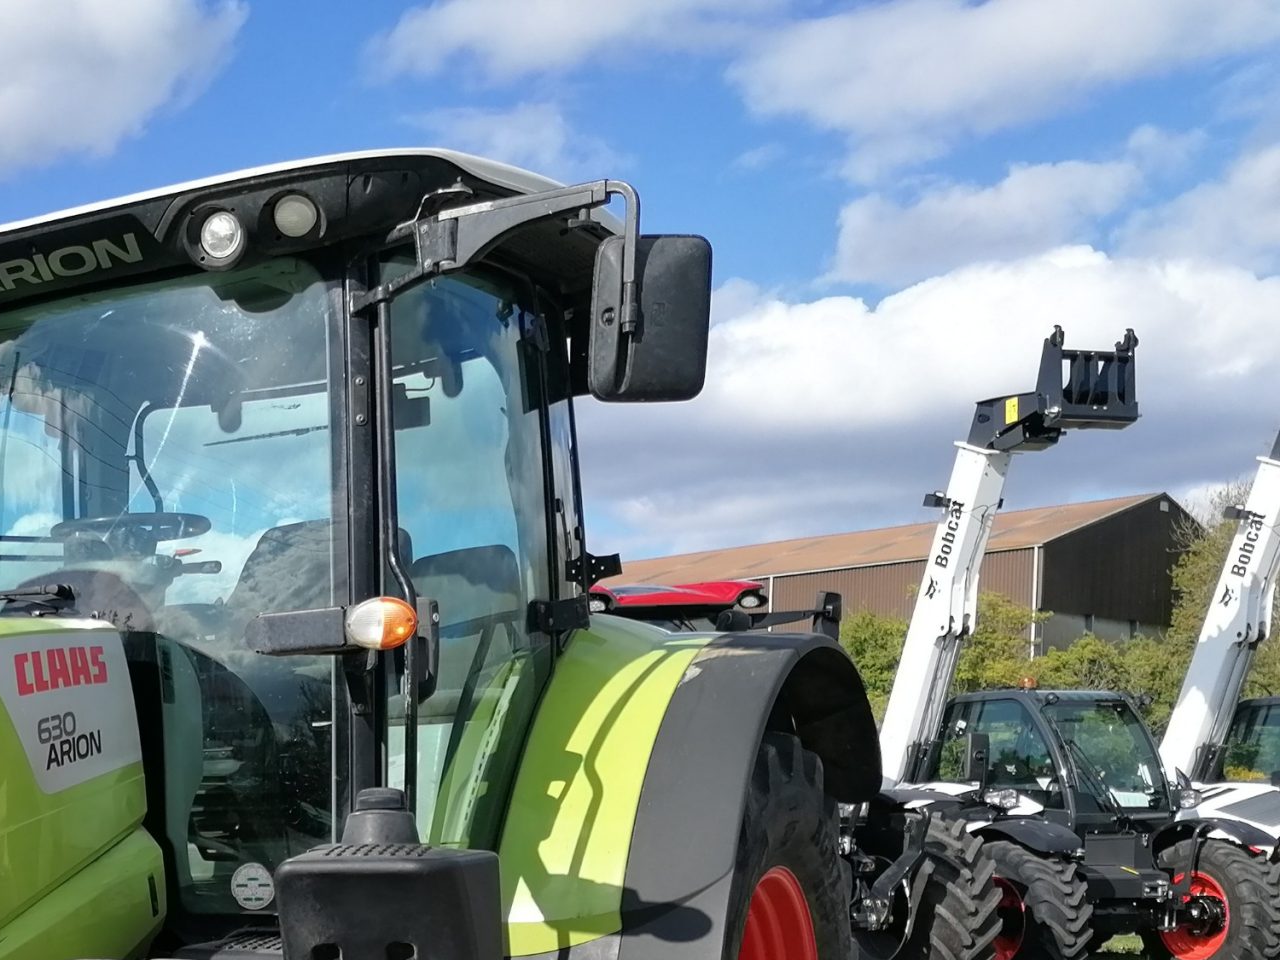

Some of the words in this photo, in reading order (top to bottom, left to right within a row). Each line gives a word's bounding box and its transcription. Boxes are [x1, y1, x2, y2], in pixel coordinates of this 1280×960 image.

[934, 500, 965, 569] Bobcat
[1231, 511, 1266, 578] Bobcat
[14, 646, 108, 696] CLAAS
[37, 711, 77, 745] 630
[46, 729, 102, 771] ARION
